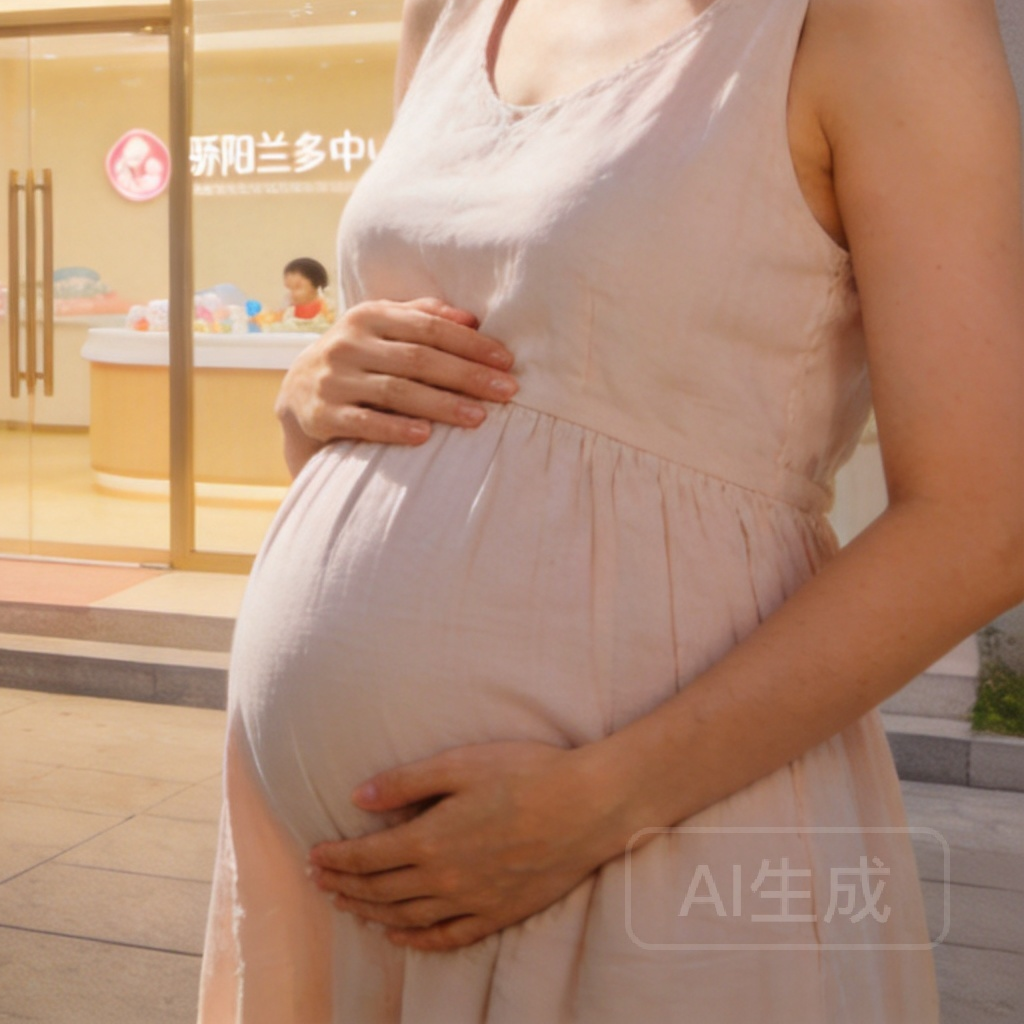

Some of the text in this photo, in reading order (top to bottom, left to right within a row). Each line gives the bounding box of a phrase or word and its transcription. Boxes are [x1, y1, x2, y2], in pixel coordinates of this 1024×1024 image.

[188, 129, 377, 176] 骄阳兰多中
